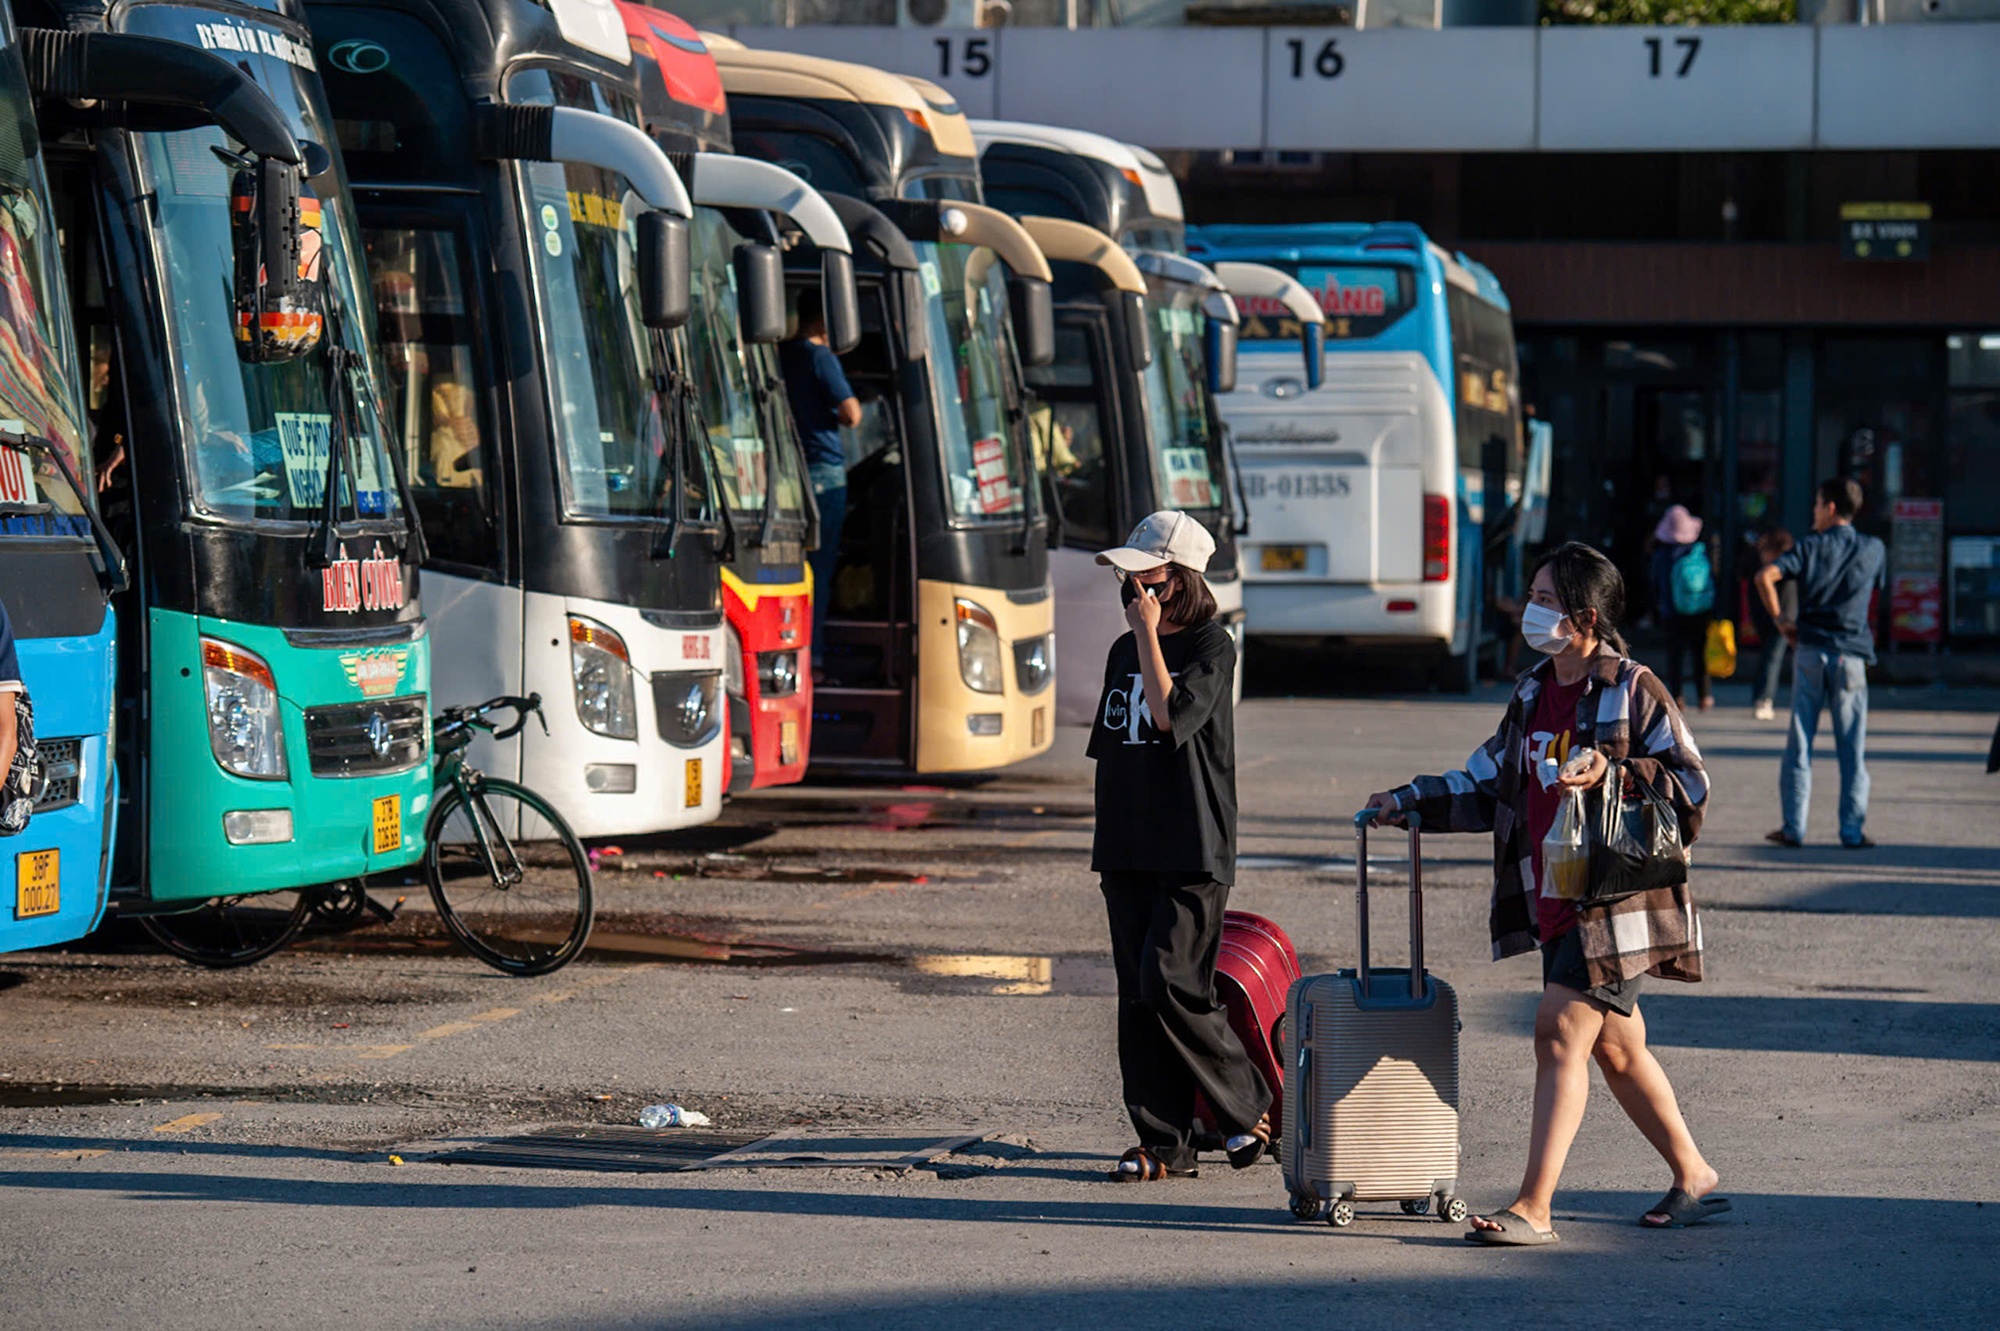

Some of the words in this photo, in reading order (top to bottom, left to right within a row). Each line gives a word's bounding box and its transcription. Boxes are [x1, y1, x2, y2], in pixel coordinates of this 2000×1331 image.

[934, 37, 992, 78] 15
[1286, 37, 1345, 78] 16
[1644, 37, 1702, 77] 17
[24, 883, 56, 913] 000.27
